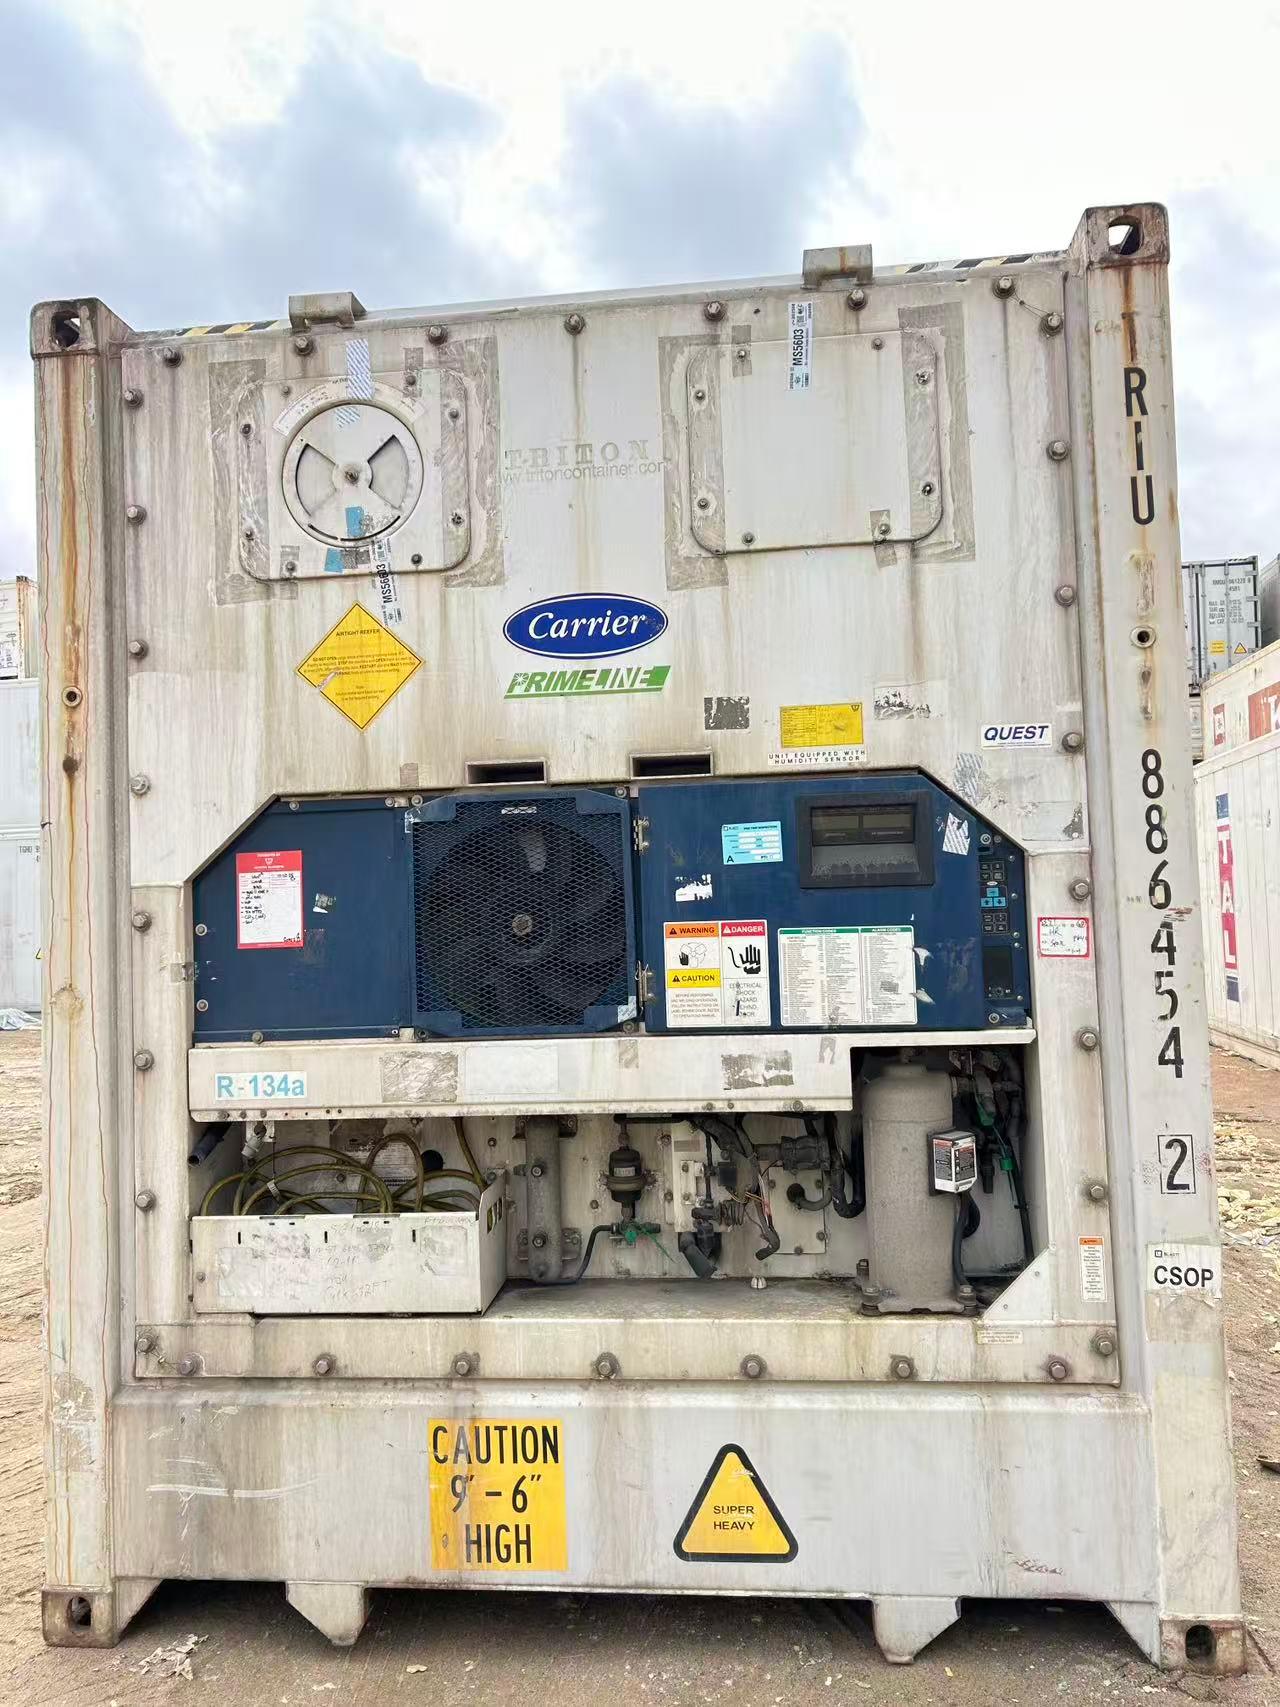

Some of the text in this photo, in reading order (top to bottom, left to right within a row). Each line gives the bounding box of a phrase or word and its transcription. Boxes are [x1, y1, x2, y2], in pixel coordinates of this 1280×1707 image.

[792, 328, 804, 366] MS5603
[528, 609, 646, 640] Carrier
[984, 725, 1049, 741] QUEST
[727, 855, 734, 863] A
[679, 926, 715, 934] WARNING
[216, 1073, 305, 1098] R-134a
[1165, 1138, 1190, 1191] 2
[1154, 1265, 1214, 1287] CSOP
[433, 1425, 559, 1464] CAUTION
[713, 1505, 755, 1514] SUPER
[713, 1521, 755, 1530] HEAVY
[465, 1524, 532, 1563] HIGH
